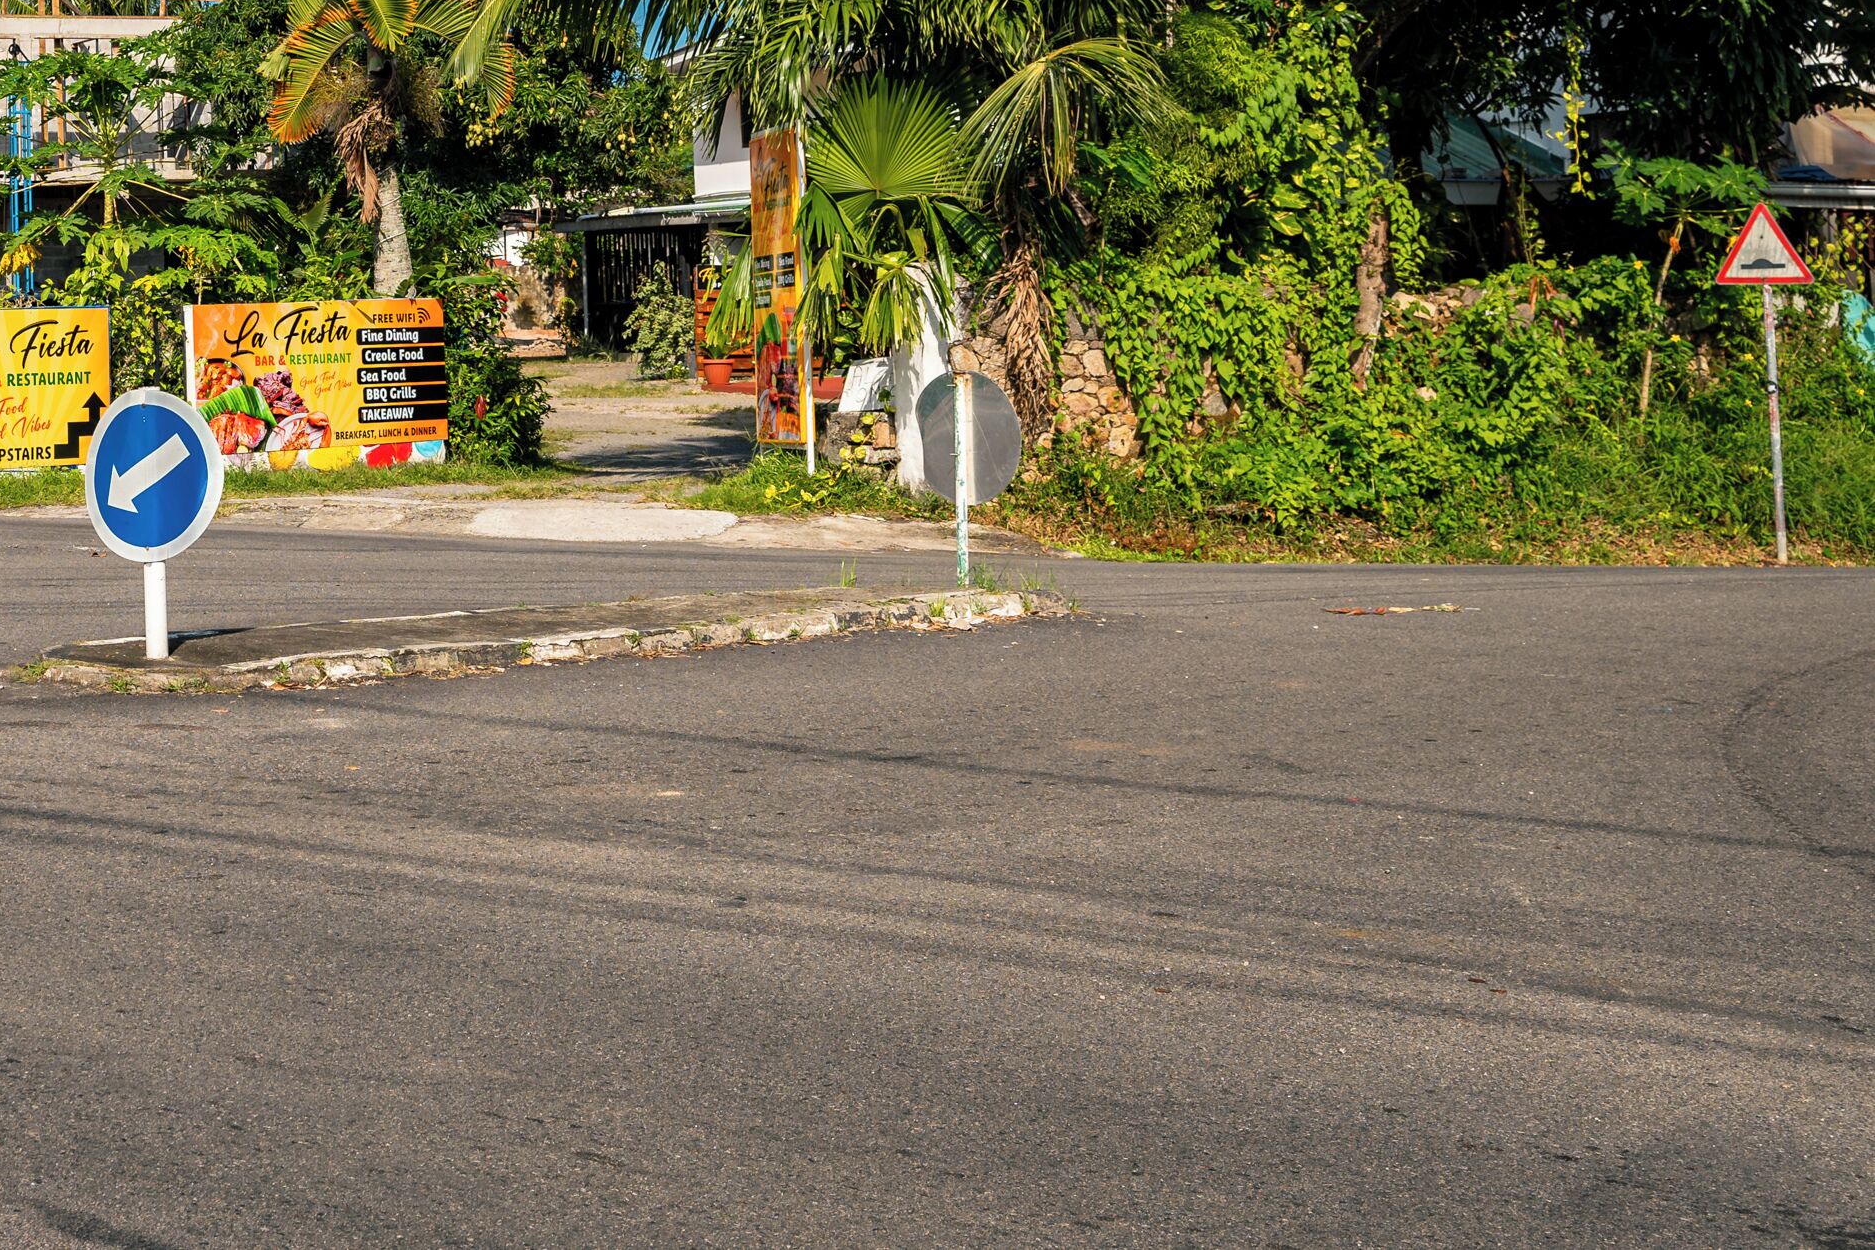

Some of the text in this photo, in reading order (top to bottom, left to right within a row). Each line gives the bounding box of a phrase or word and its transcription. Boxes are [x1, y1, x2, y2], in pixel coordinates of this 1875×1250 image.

[373, 313, 416, 324] FREE WIFI
[224, 306, 352, 358] La Fiesta
[361, 329, 419, 343] Fine Dining
[9, 319, 94, 369] Fiesta
[255, 353, 352, 366] BAR & RESTAURANT
[365, 348, 424, 362] Creole Food
[7, 371, 91, 386] RESTAURANT
[360, 369, 406, 382] Sea Food
[366, 387, 417, 402] BBQ Grills
[361, 407, 414, 421] TAKEAWAY
[12, 414, 52, 439] Vibes
[335, 426, 437, 440] BREAKFAST, LUNCH & DINNER
